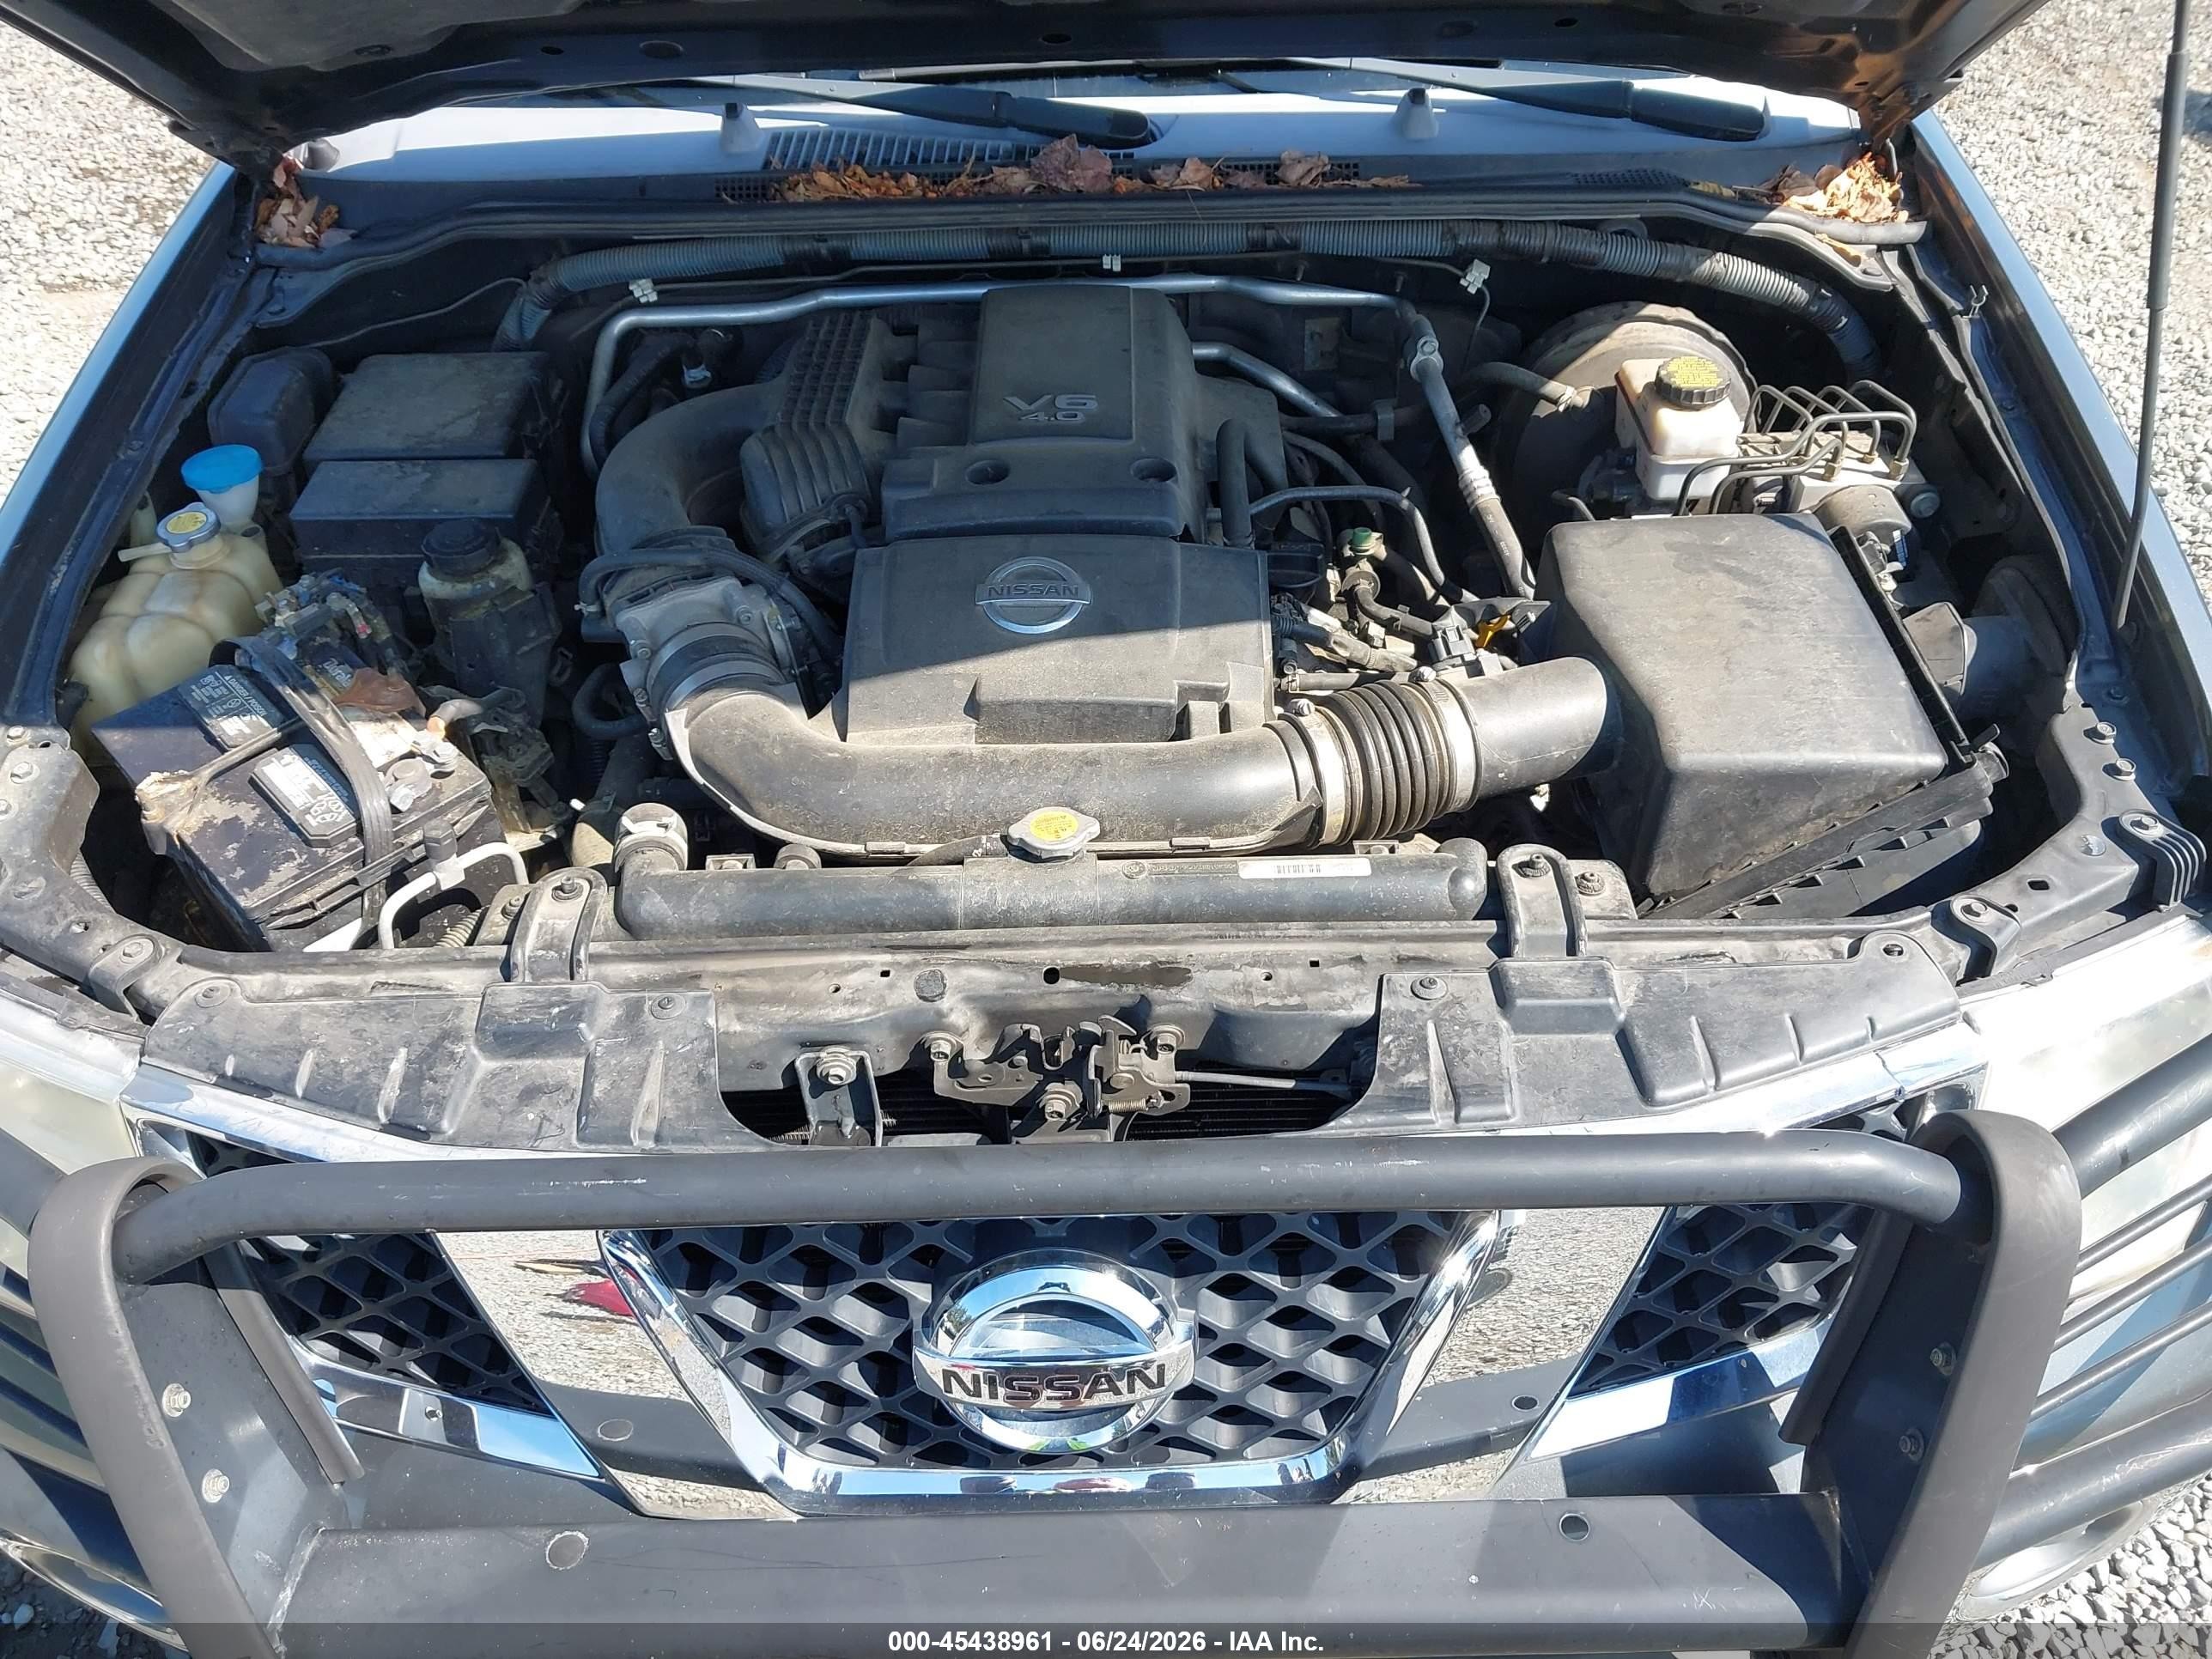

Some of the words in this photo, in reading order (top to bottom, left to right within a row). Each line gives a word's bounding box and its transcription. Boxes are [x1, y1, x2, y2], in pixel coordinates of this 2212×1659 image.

[1003, 393, 1098, 411] V6
[1018, 410, 1085, 423] 4.0
[988, 582, 1079, 598] NISSAN
[941, 1363, 1165, 1401] NISSAN
